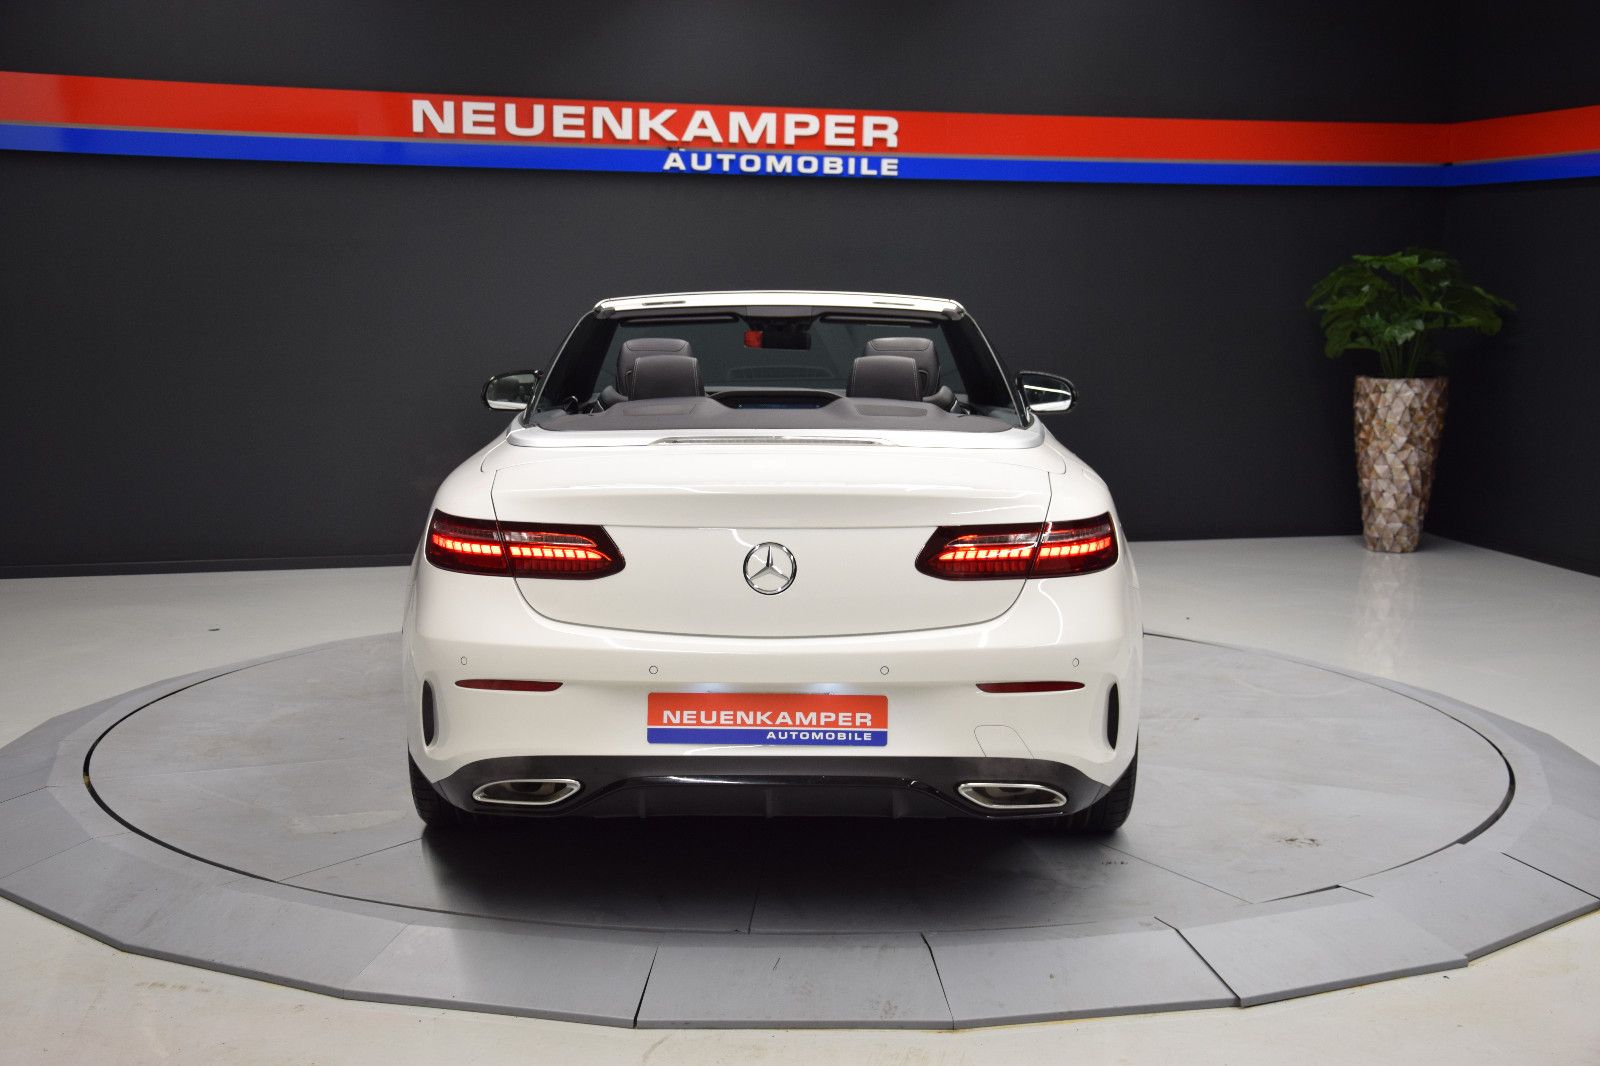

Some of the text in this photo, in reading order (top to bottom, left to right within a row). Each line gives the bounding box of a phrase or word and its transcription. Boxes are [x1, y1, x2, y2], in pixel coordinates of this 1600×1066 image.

[412, 99, 899, 148] NEUENKAMPER
[663, 152, 899, 176] AUTOMOBILE
[662, 710, 872, 727] NEUENKAMPER
[766, 731, 872, 741] AUTOMOBILE
